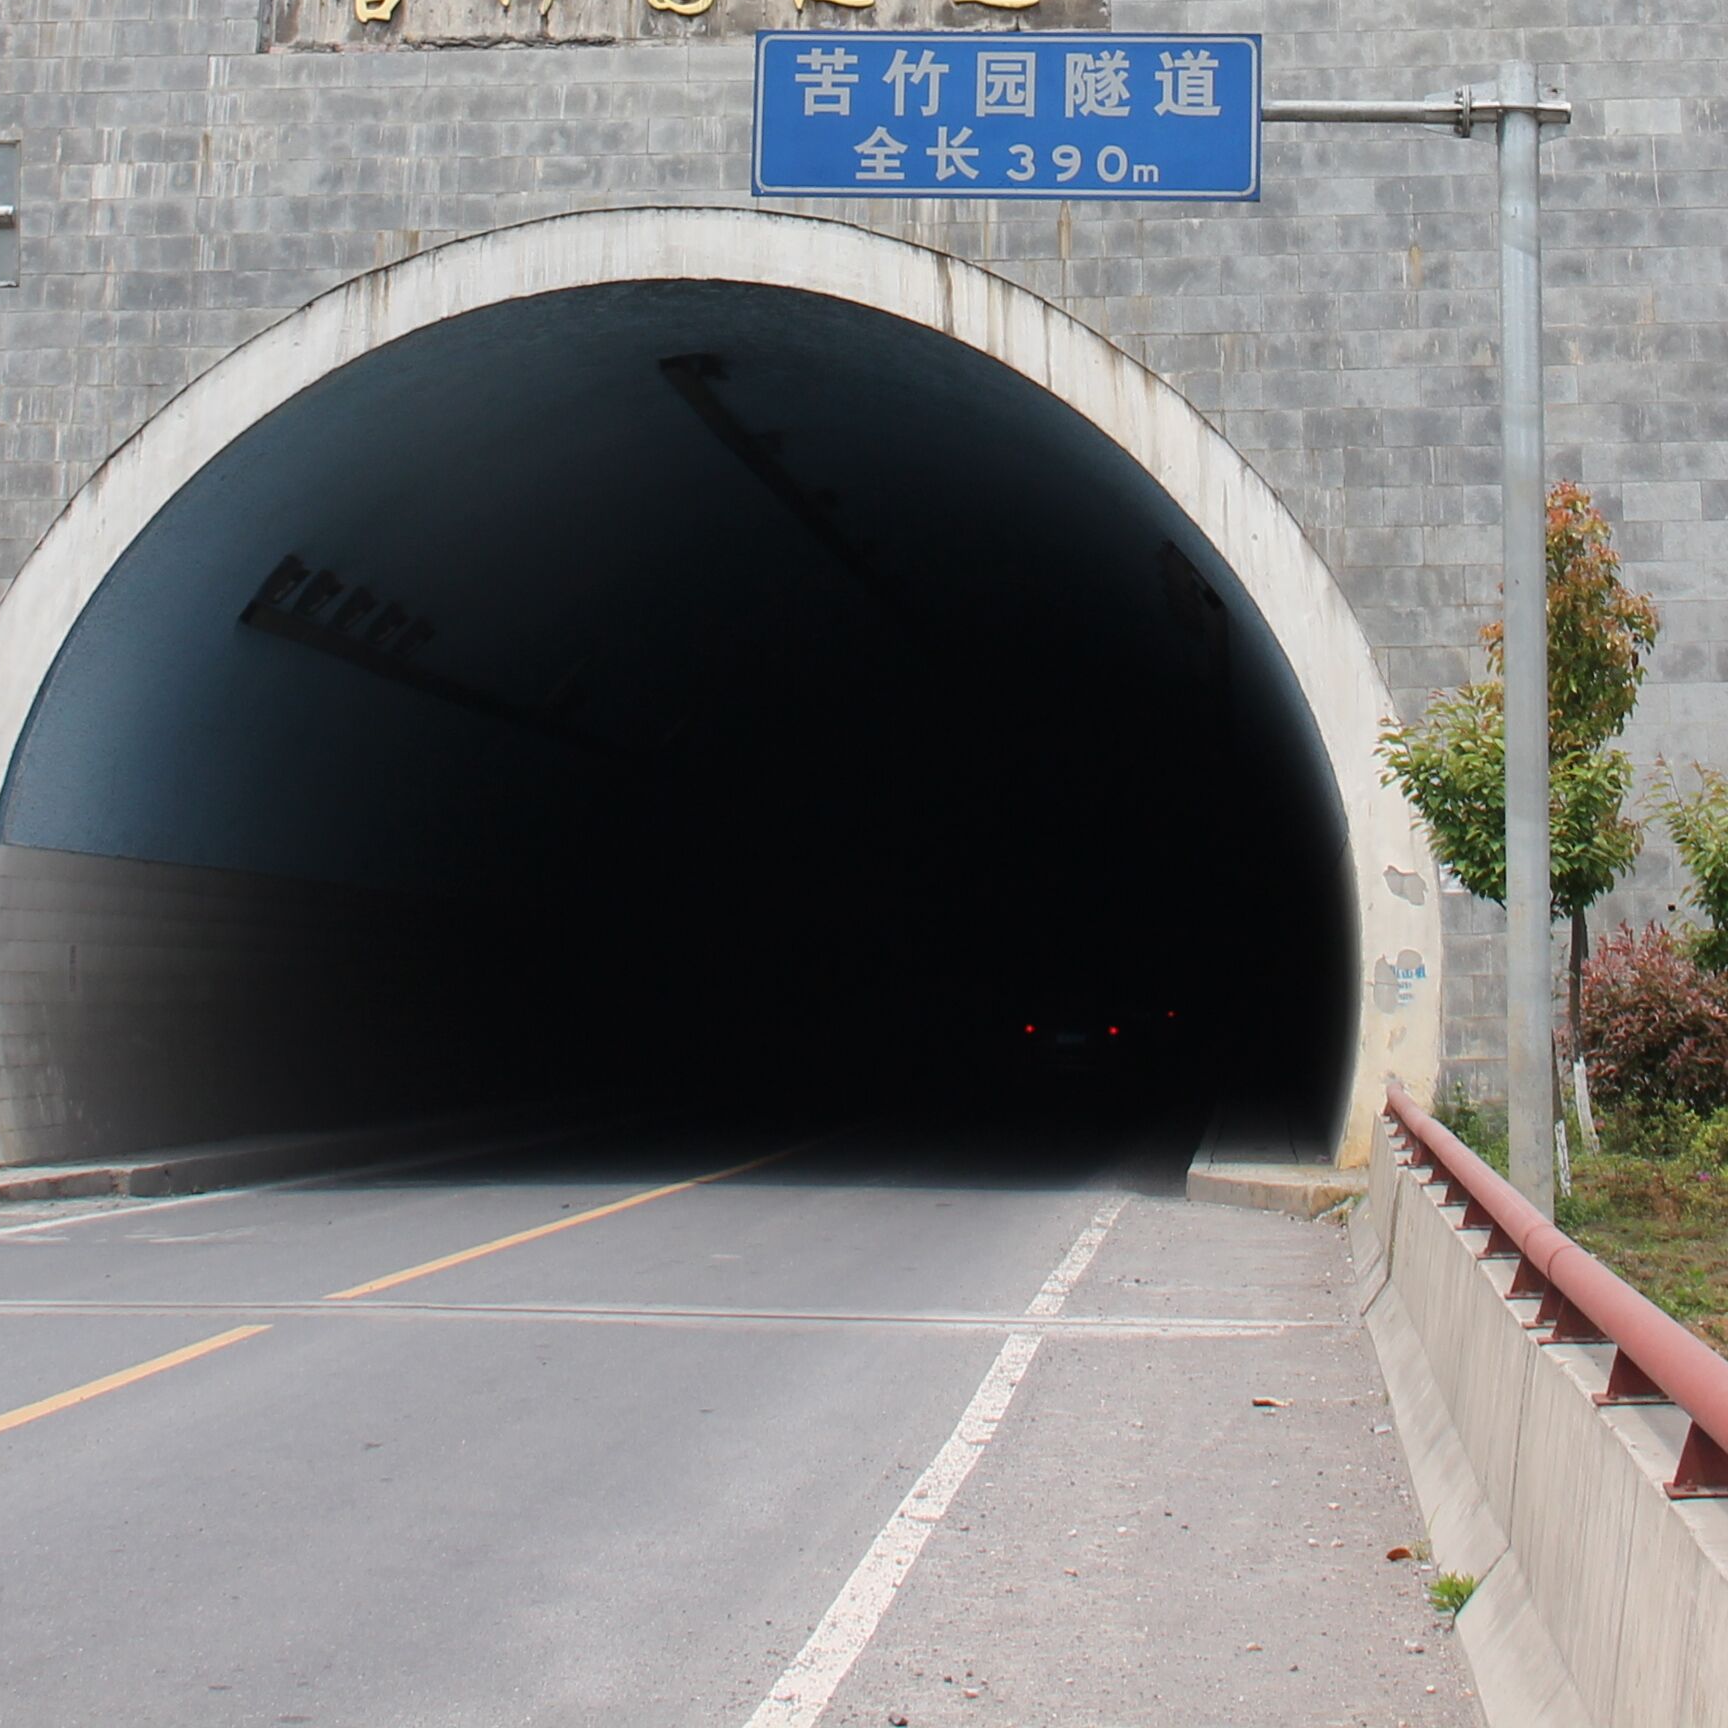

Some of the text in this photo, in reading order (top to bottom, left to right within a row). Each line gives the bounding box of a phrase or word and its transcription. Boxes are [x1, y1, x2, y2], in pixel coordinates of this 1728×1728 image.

[794, 47, 1222, 119] 苦竹园隧道
